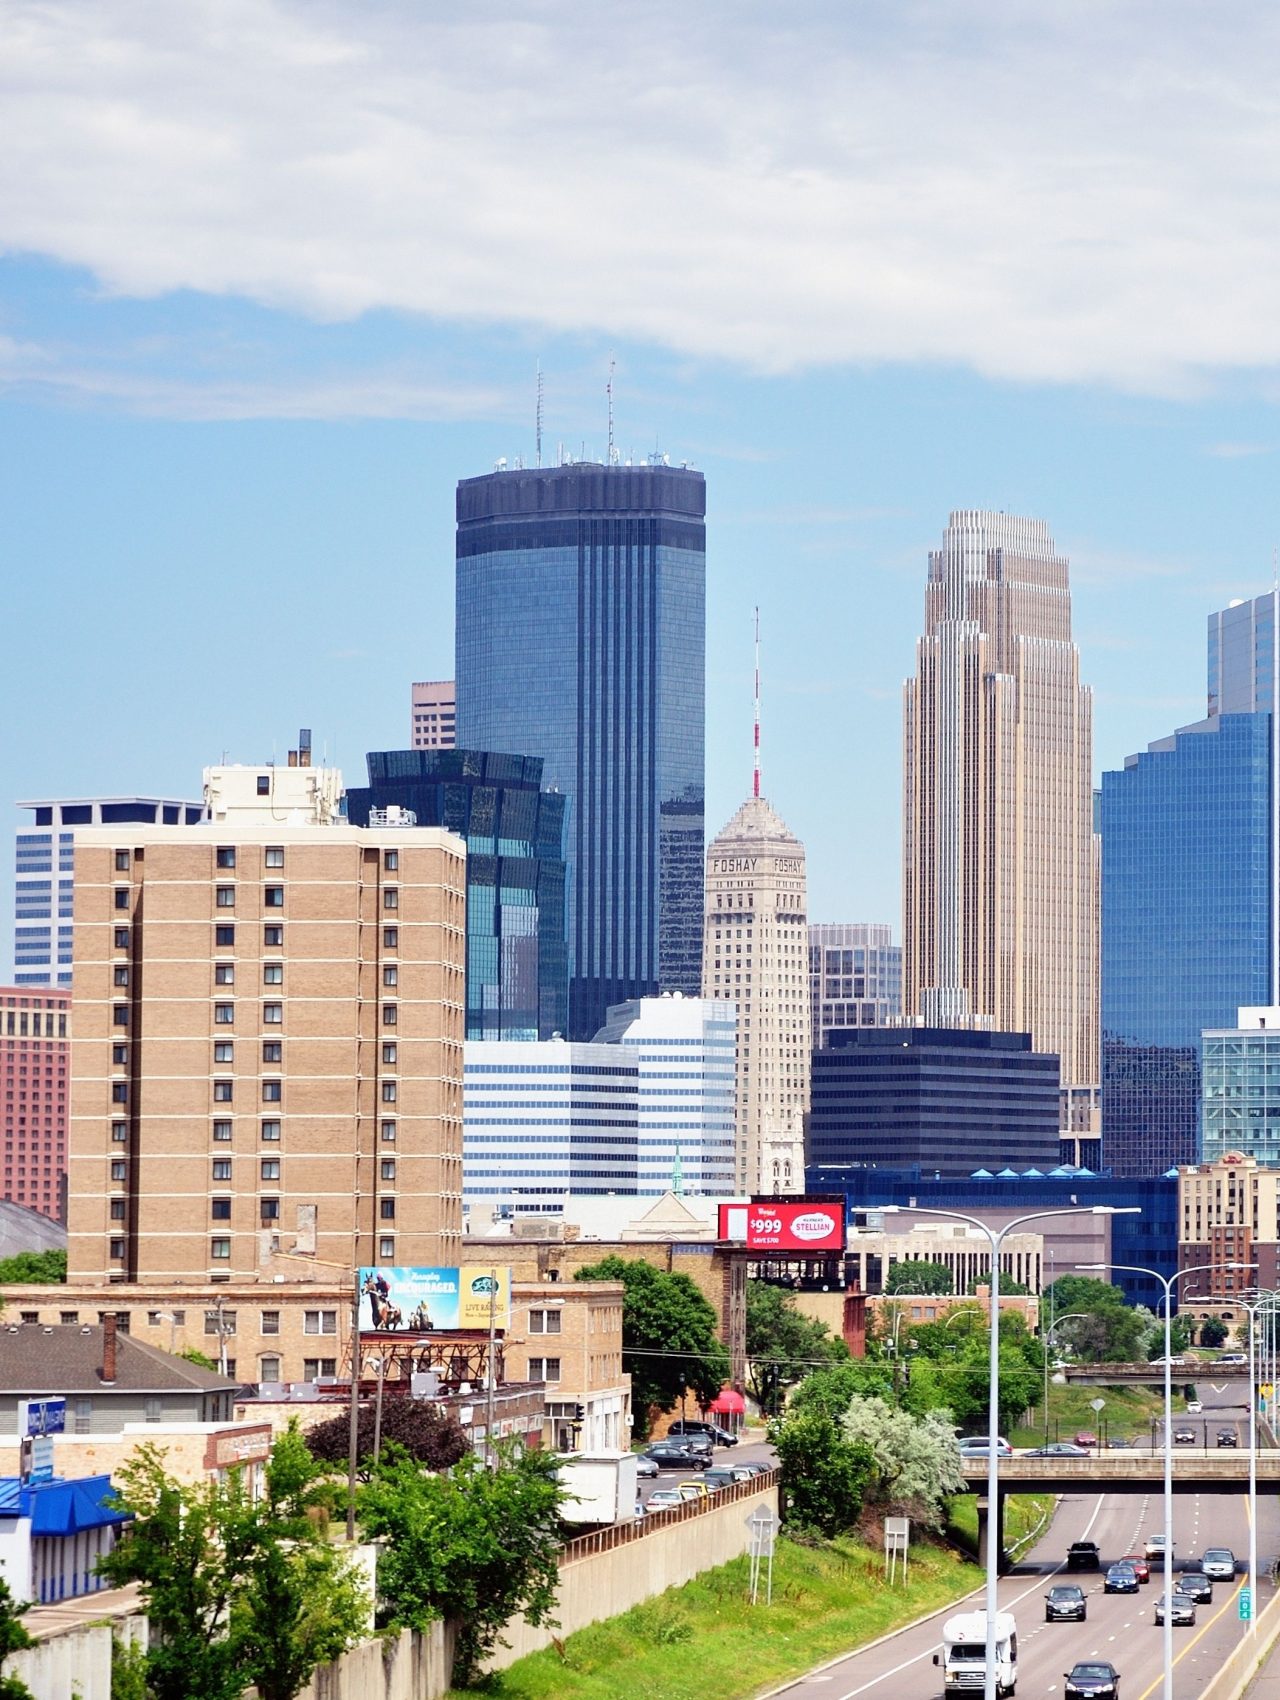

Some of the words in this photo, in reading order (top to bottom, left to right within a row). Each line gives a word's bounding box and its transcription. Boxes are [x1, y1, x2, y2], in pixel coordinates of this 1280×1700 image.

[713, 858, 758, 873] FOSHAY
[774, 858, 802, 873] FOSHAY
[750, 1219, 782, 1234] $999
[796, 1223, 830, 1231] STELLIAN
[465, 1303, 480, 1311] LIVE
[481, 1303, 505, 1311] RANG
